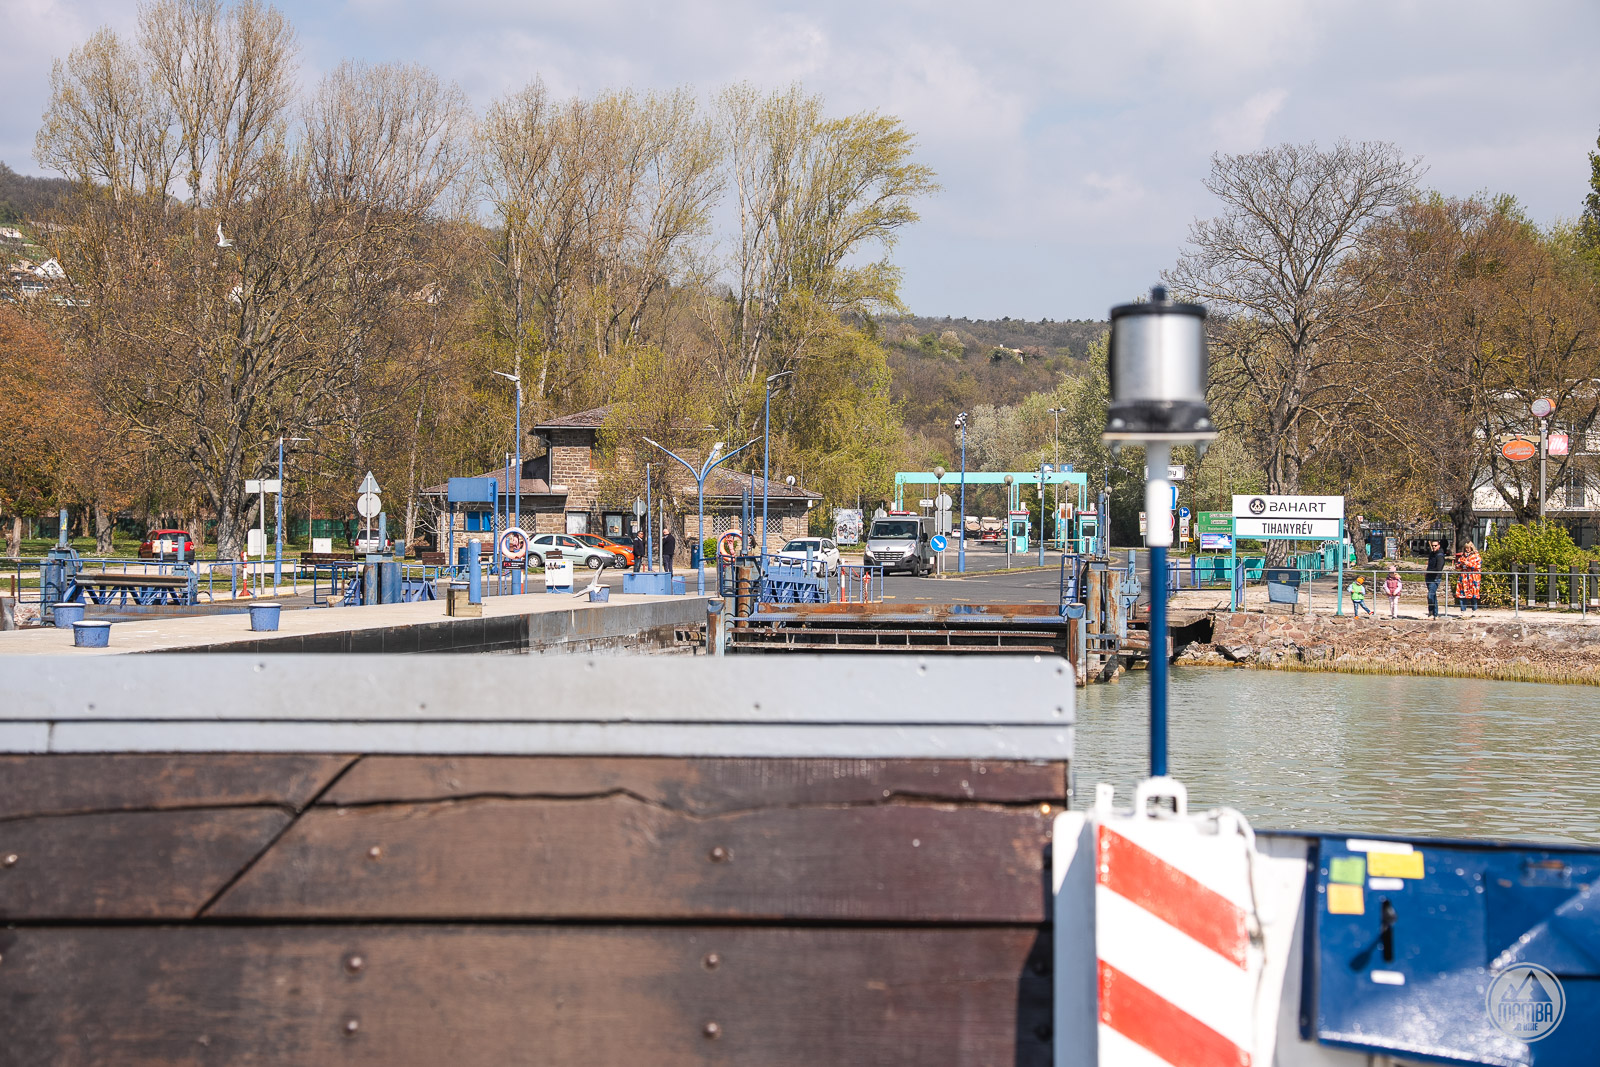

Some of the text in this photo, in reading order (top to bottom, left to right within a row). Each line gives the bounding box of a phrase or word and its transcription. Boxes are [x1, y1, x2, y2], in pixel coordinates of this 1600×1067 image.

[1550, 437, 1567, 453] illy
[1269, 502, 1326, 513] BAHART
[1262, 521, 1313, 535] TIHANYRÉV
